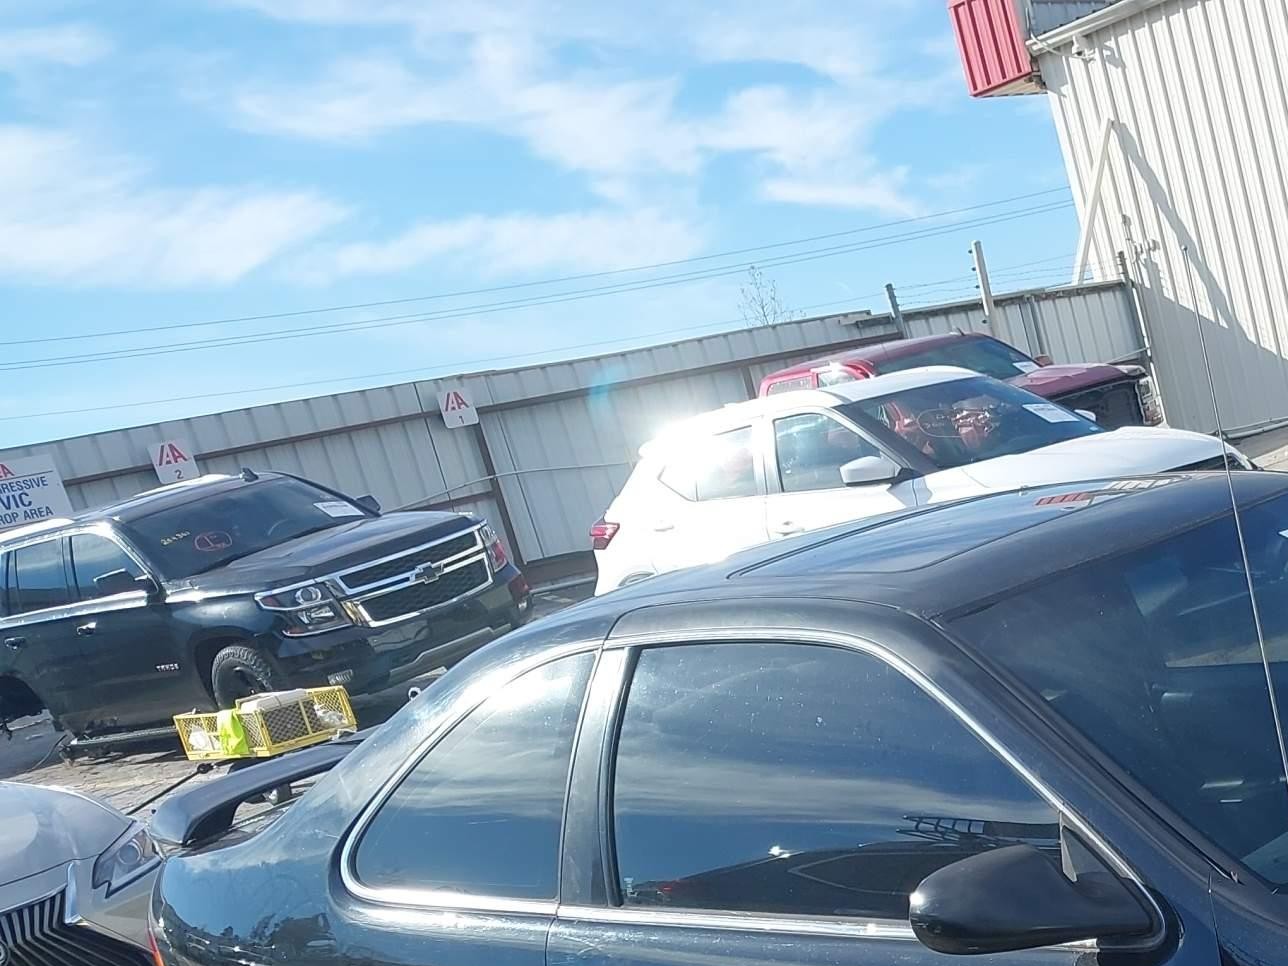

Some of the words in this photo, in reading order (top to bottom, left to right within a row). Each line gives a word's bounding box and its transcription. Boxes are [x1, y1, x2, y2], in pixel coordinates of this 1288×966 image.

[445, 391, 469, 411] IAA
[459, 415, 464, 424] 1
[159, 443, 187, 466] IAA
[174, 469, 184, 479] 2
[0, 476, 48, 494] RESSIVE
[23, 505, 54, 520] AREA
